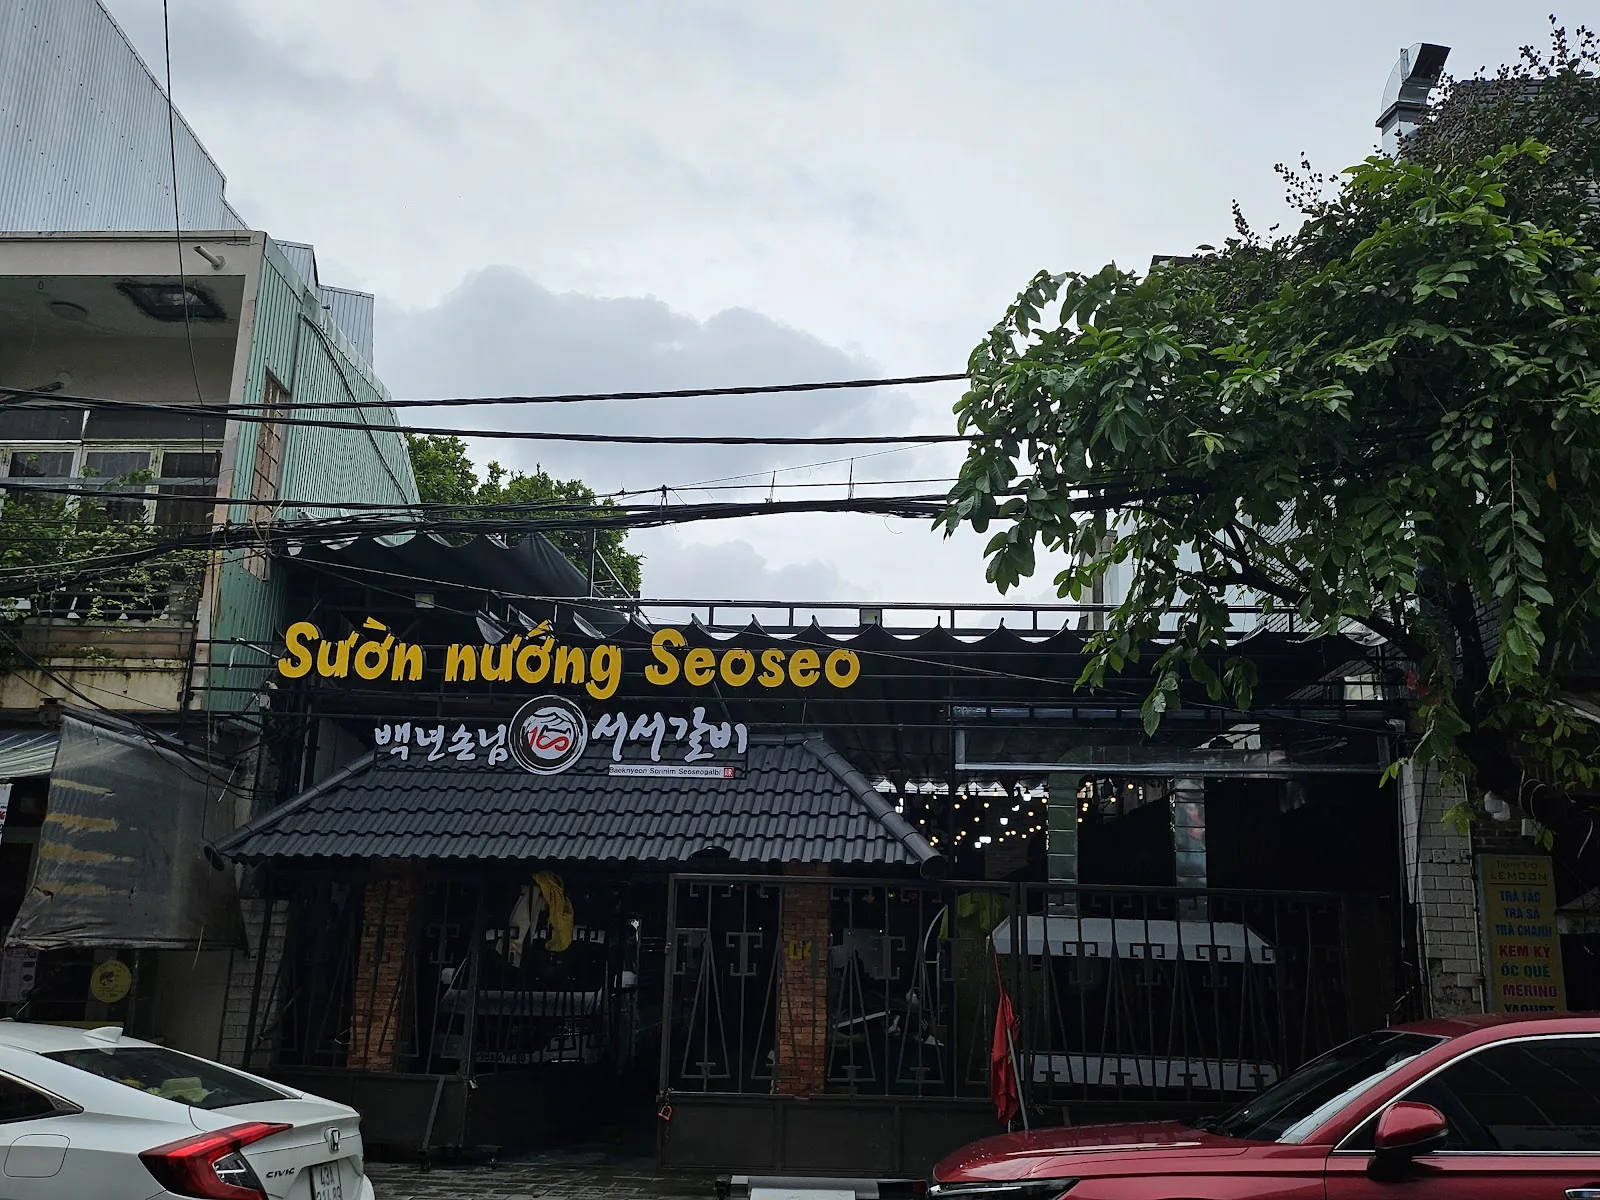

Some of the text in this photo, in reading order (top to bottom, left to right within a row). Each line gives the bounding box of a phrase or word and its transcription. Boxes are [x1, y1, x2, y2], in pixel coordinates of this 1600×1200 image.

[278, 616, 860, 699] Sườn nướng Seoseo
[592, 707, 748, 763] 서서갈비
[374, 721, 510, 765] 백년손님
[609, 766, 647, 775] Baeknyeon
[650, 767, 676, 775] Sonnim
[1517, 924, 1552, 937] CHANH
[1499, 944, 1529, 957] KEM
[1503, 983, 1557, 998] MERINO
[266, 1167, 295, 1179] CIVIC
[320, 1165, 335, 1187] 43A
